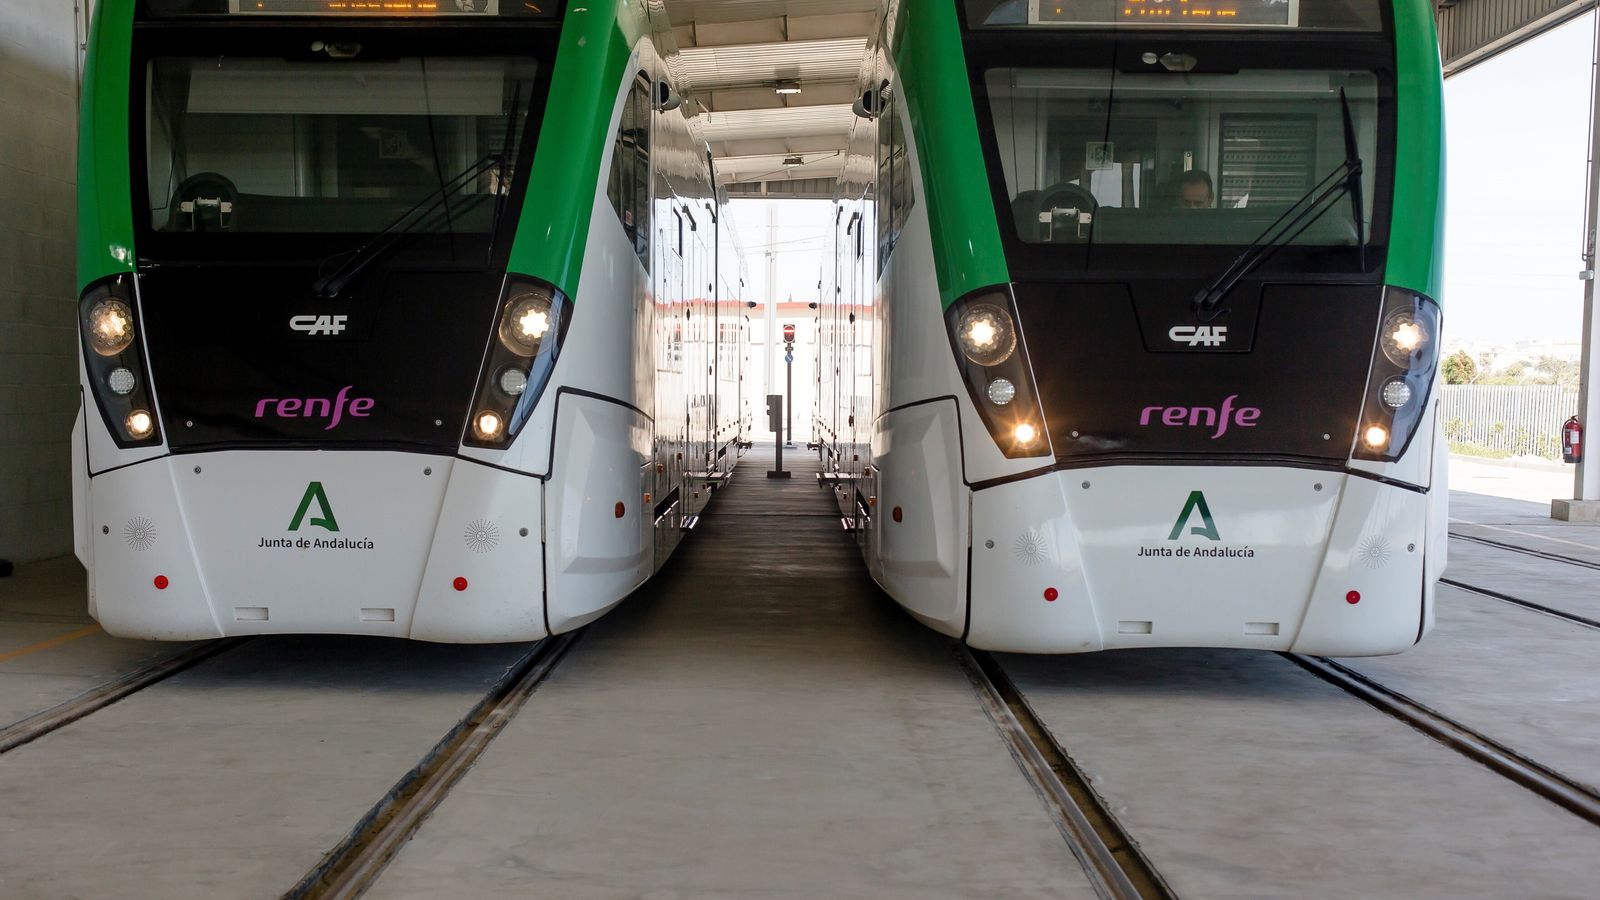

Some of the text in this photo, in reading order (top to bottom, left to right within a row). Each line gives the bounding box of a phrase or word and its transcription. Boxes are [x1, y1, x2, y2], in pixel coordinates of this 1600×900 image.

[289, 315, 348, 335] CAF
[1168, 326, 1228, 346] CAF
[254, 385, 375, 430] renfe
[1139, 394, 1261, 439] renfe
[258, 537, 374, 550] Junta de Andalucía
[1137, 545, 1255, 558] Junta de Andalucía
